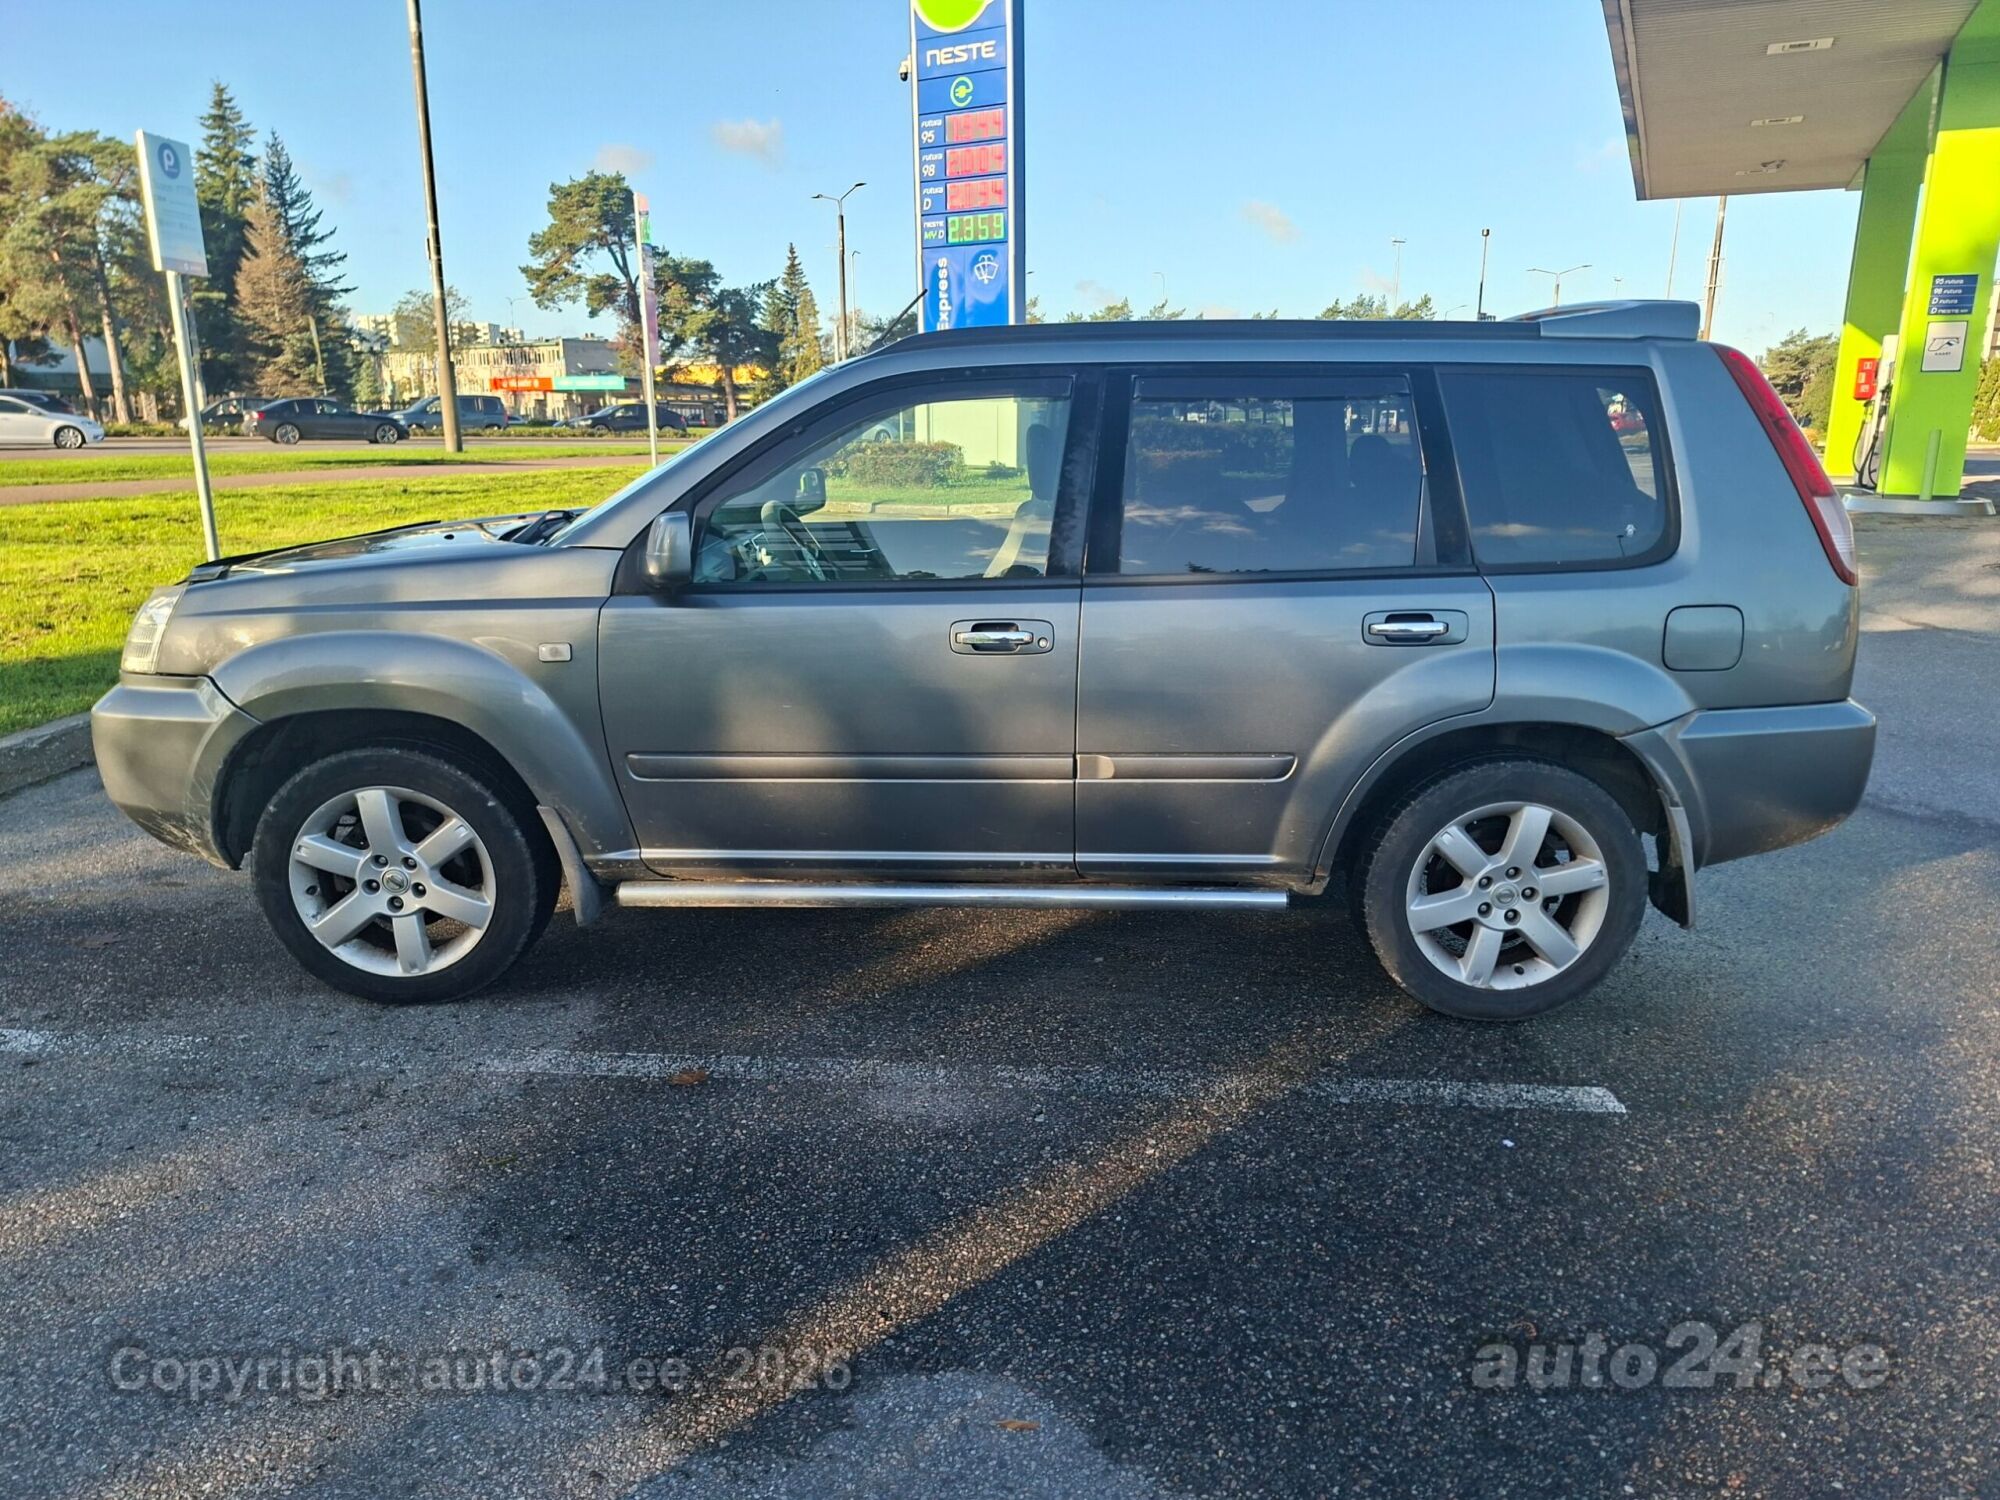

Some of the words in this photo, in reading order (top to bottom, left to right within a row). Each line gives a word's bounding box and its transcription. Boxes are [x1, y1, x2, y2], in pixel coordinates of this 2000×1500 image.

[926, 40, 996, 67] NESTE
[921, 130, 935, 144] 95
[922, 164, 936, 177] 98
[923, 198, 932, 211] D
